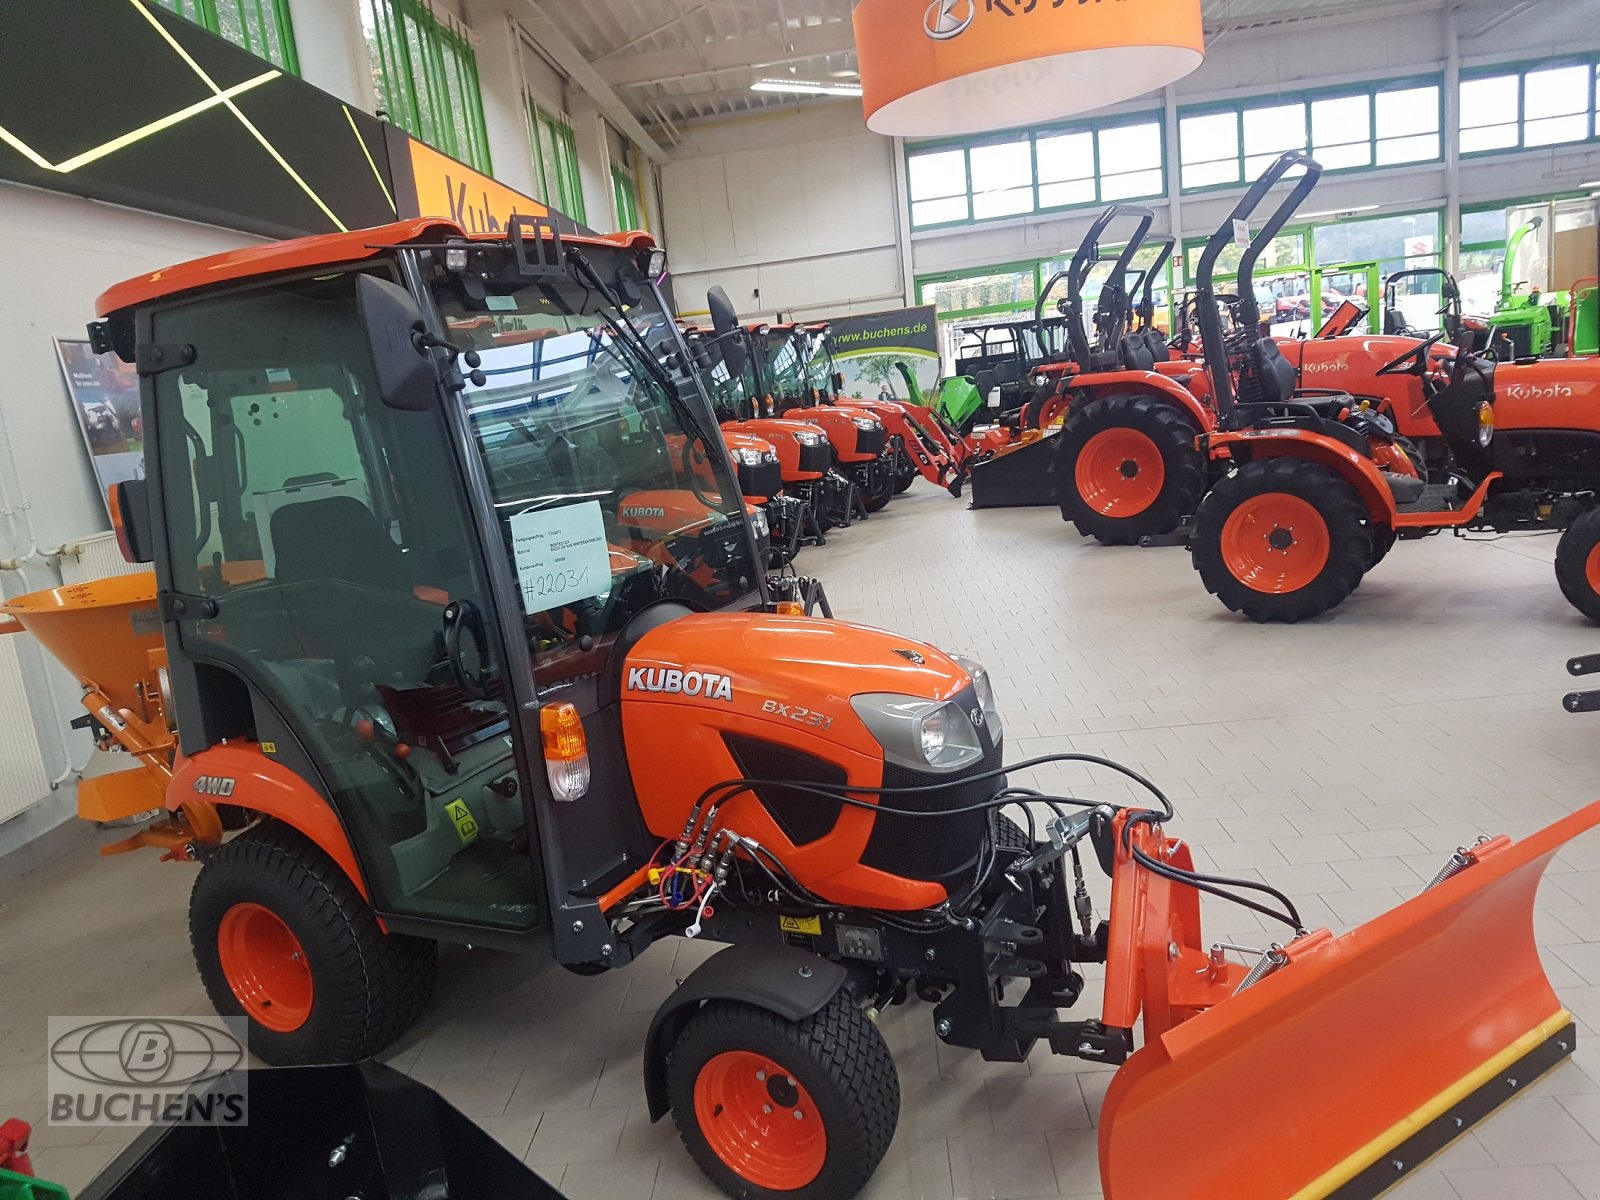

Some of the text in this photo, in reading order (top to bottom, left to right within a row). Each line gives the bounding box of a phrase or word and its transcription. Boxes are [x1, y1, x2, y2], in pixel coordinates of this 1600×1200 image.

[1304, 362, 1349, 373] Kubota
[1507, 384, 1572, 399] Kubota
[622, 507, 665, 518] KUBOTA
[523, 566, 589, 603] #22031
[627, 667, 733, 701] KUBOTA
[761, 699, 834, 731] BX231
[193, 775, 236, 797] 4WD
